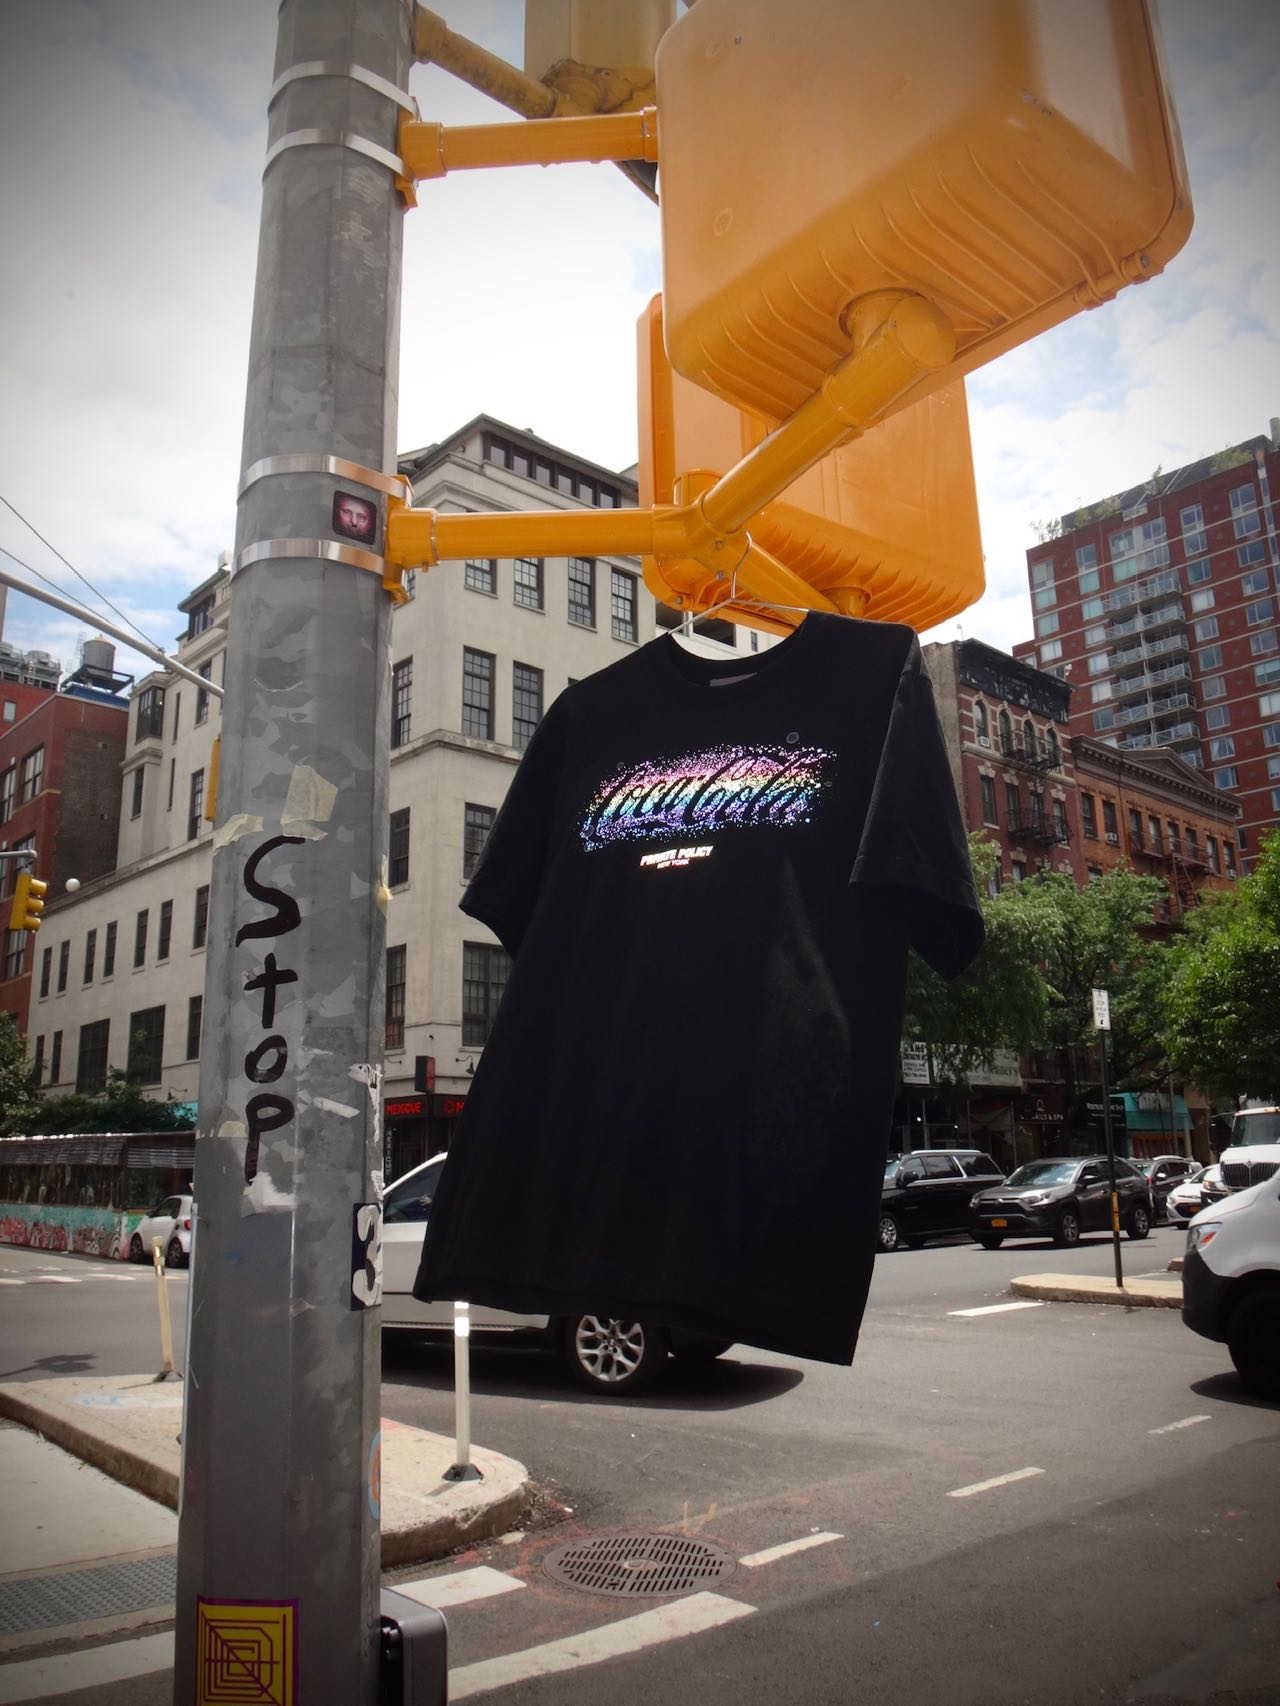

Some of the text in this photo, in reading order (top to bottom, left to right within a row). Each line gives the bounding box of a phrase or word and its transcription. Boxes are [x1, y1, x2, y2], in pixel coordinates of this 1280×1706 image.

[639, 845, 714, 867] PRIVATE POLICY
[656, 858, 690, 869] NEW YORK
